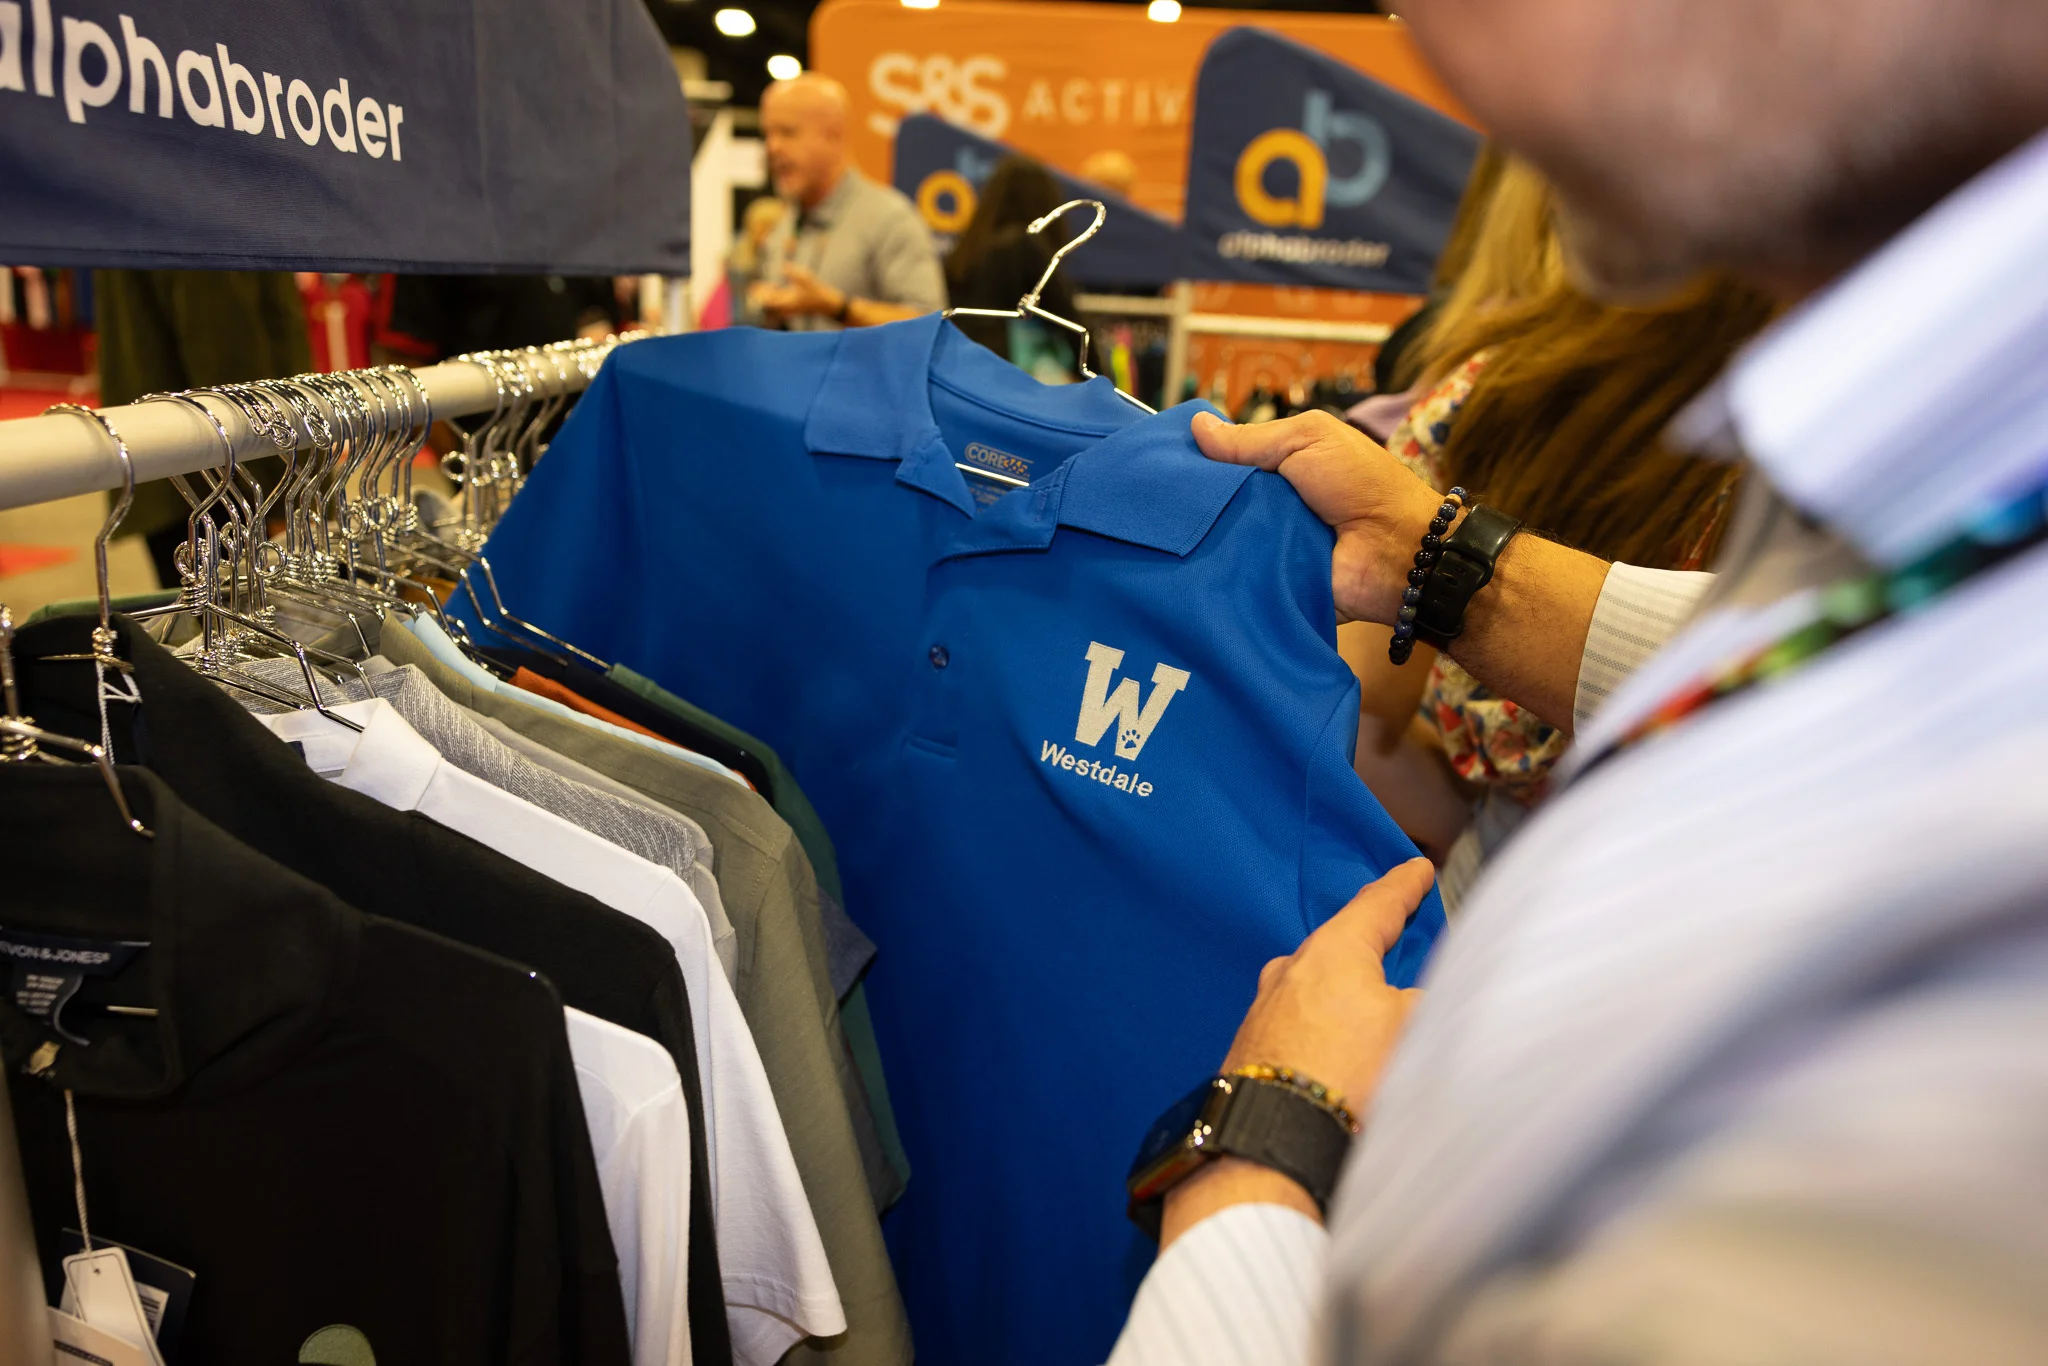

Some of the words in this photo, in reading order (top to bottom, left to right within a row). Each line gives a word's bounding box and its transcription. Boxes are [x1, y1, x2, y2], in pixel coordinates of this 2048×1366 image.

[868, 53, 1010, 139] S&S
[1075, 641, 1191, 761] W
[1040, 740, 1154, 796] Westdale
